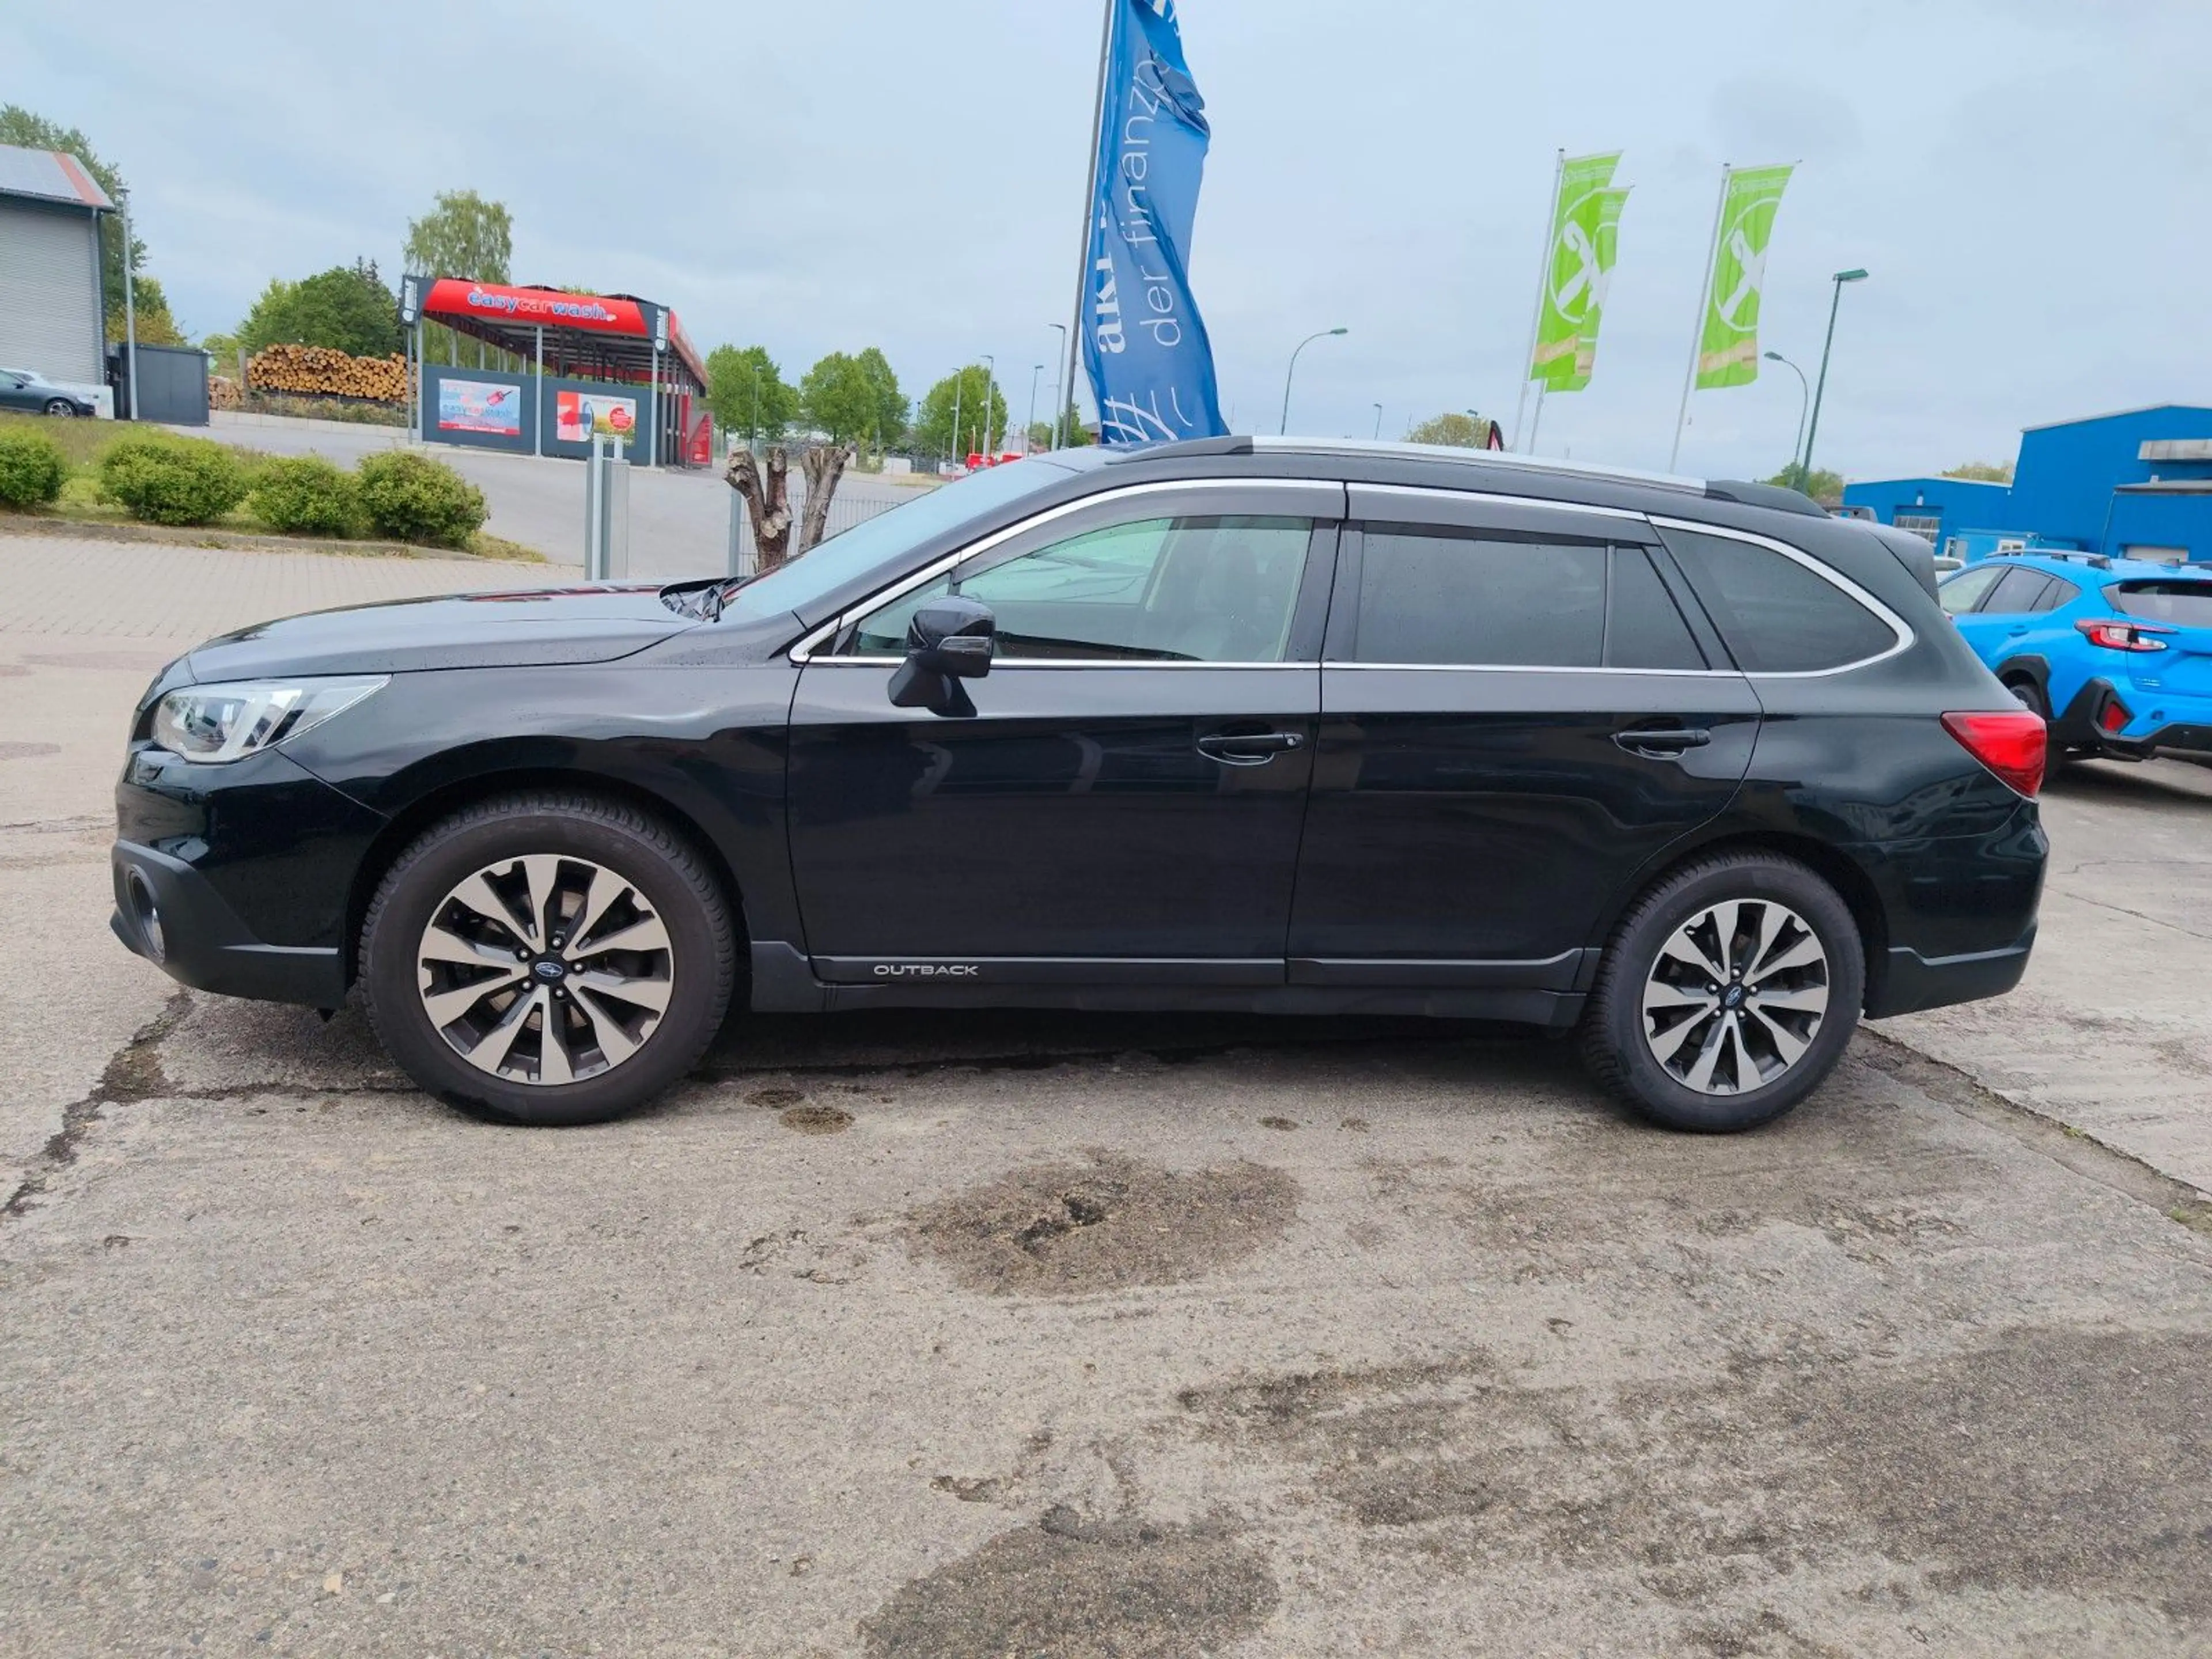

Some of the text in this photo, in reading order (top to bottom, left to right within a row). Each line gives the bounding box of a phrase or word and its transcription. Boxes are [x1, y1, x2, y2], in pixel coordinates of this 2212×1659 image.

[467, 290, 607, 321] easycarwash
[1139, 265, 1181, 346] der
[873, 965, 979, 975] OUTBACK
